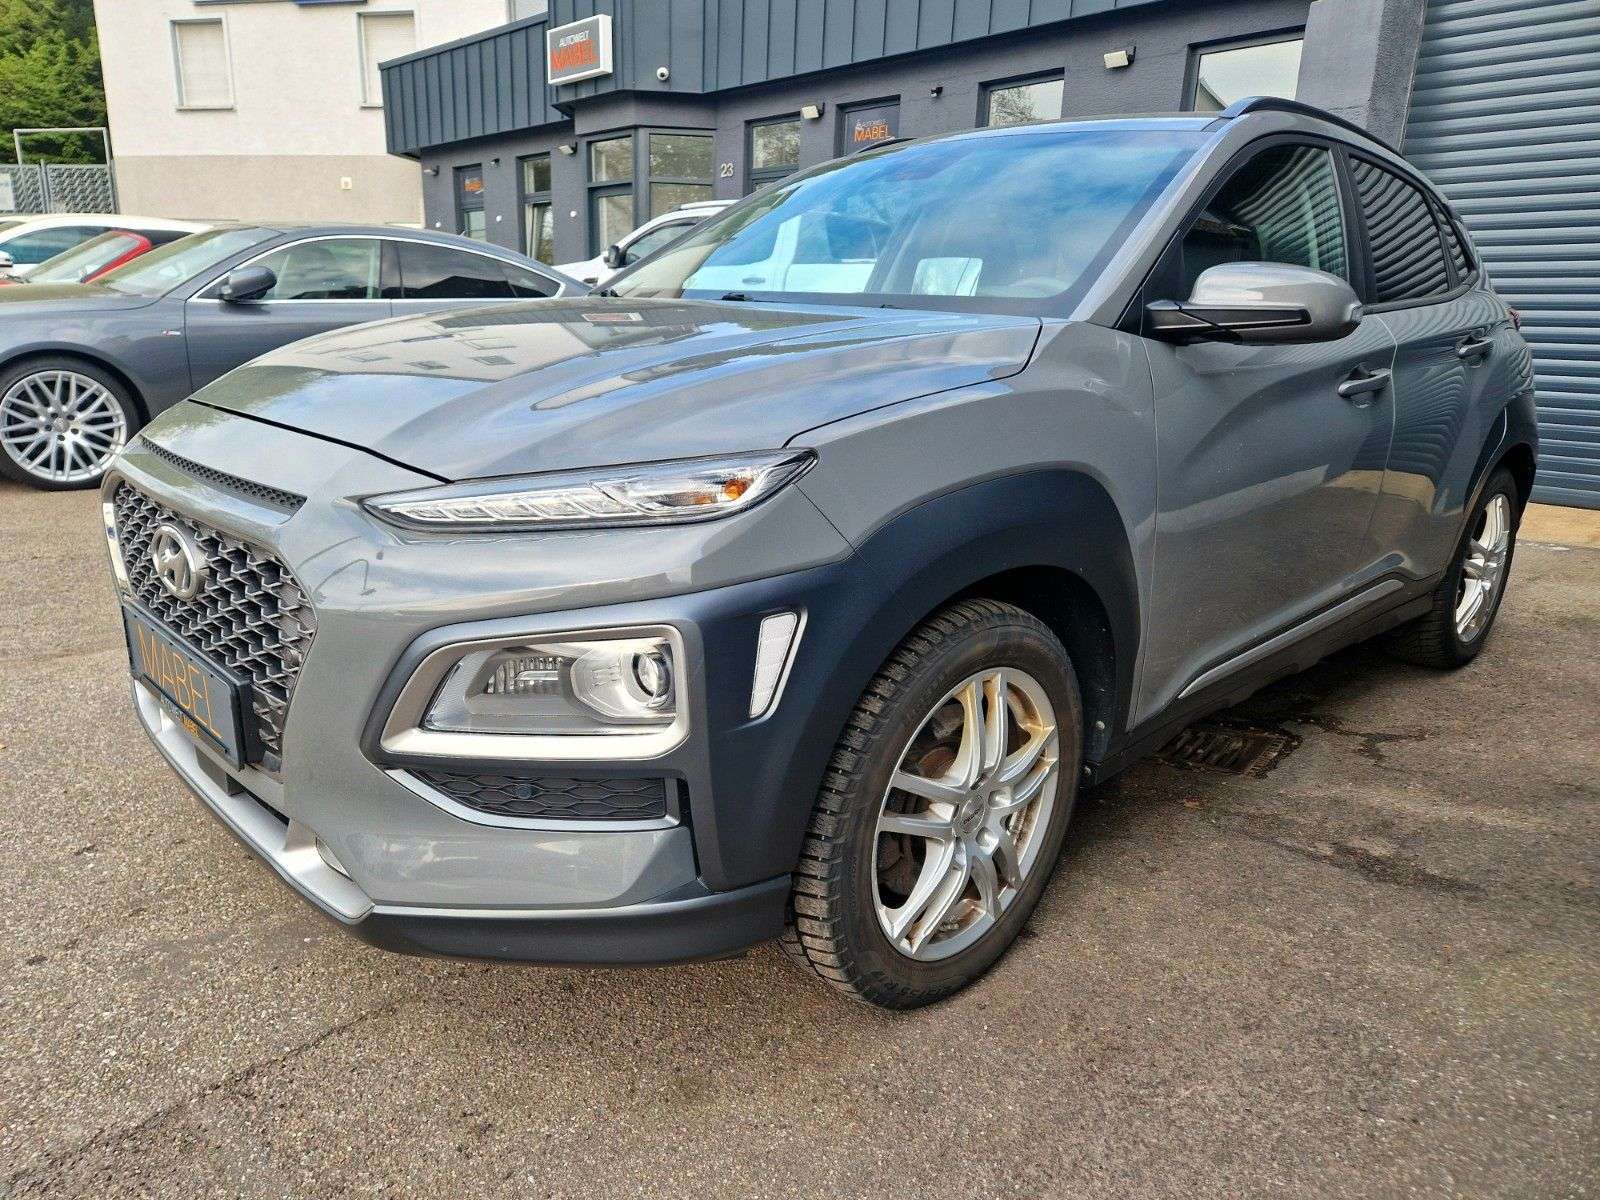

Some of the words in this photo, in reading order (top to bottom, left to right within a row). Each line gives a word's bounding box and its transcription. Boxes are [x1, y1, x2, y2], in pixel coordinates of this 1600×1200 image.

[552, 38, 597, 71] MABEL
[855, 125, 891, 142] MABEL
[720, 162, 734, 178] 23
[137, 623, 225, 740] MABEL
